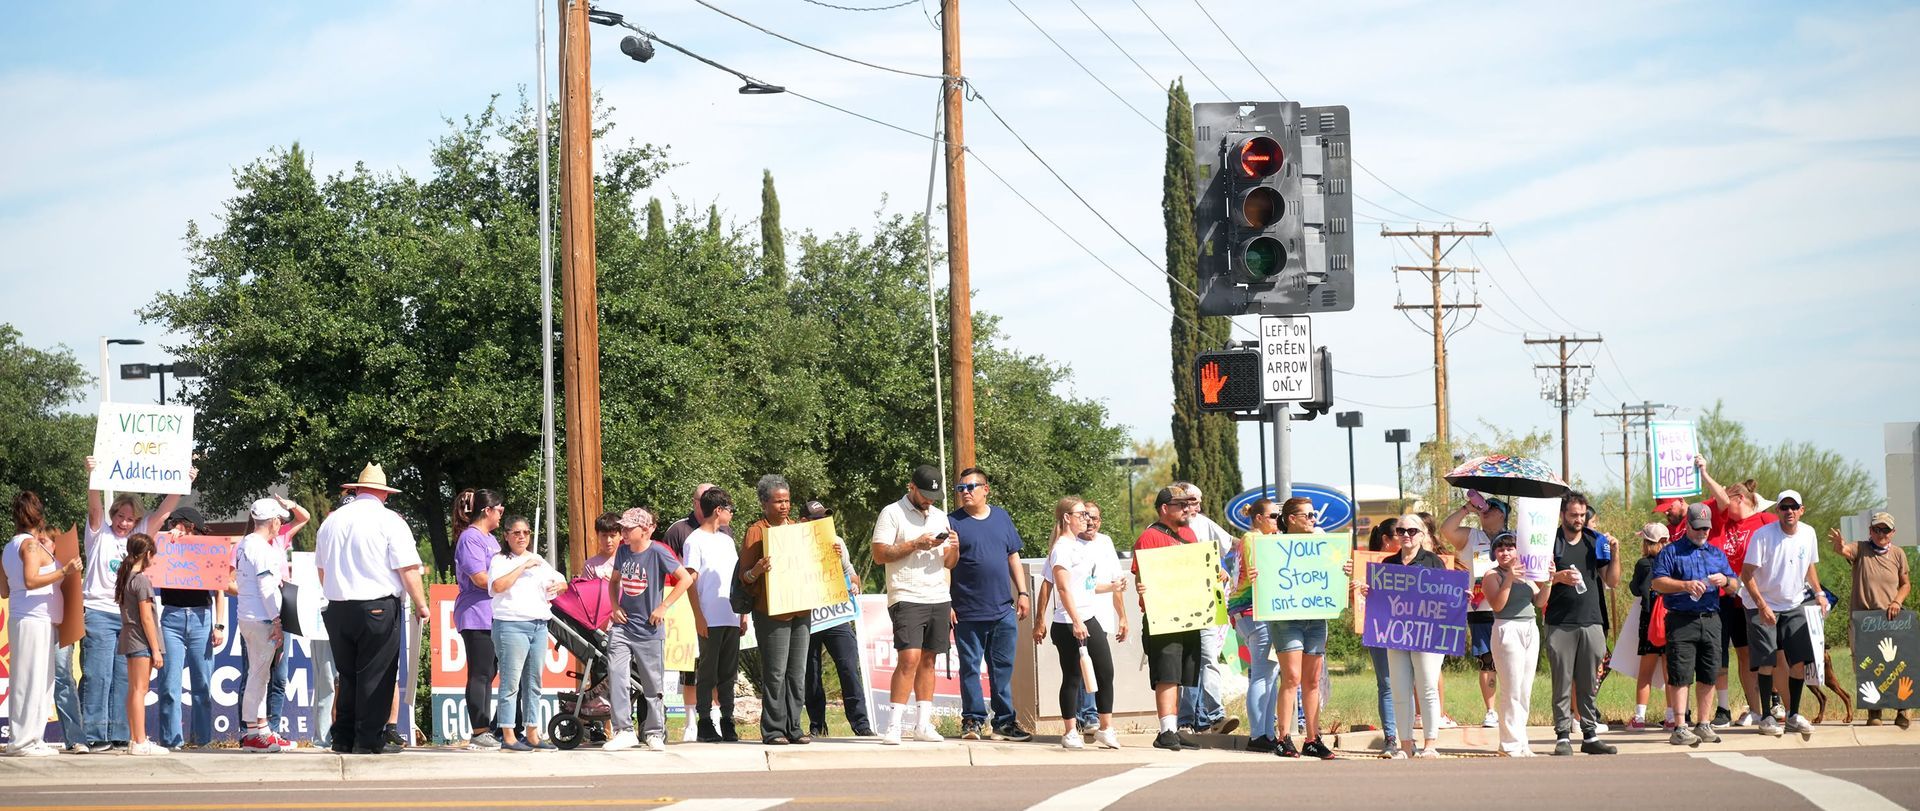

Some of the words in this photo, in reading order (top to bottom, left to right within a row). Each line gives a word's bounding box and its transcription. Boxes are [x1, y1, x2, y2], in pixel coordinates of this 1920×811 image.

[1265, 324, 1288, 337] LEFT
[1293, 324, 1306, 337] ON
[1268, 342, 1305, 355] GREEN
[1266, 361, 1307, 374] ARROW
[1272, 379, 1302, 392] ONLY
[119, 412, 183, 434] VICTORY
[133, 441, 168, 456] over
[1670, 448, 1682, 462] IS
[109, 460, 182, 480] Addiction
[1659, 465, 1694, 488] HOPE
[1529, 533, 1549, 546] ARE
[1371, 563, 1416, 592] KEEP
[1417, 568, 1464, 608] Going
[1417, 599, 1448, 620] ARE
[1373, 618, 1434, 649] WORTH
[1434, 624, 1466, 652] IT
[1859, 656, 1874, 670] WE
[1873, 662, 1886, 677] DO
